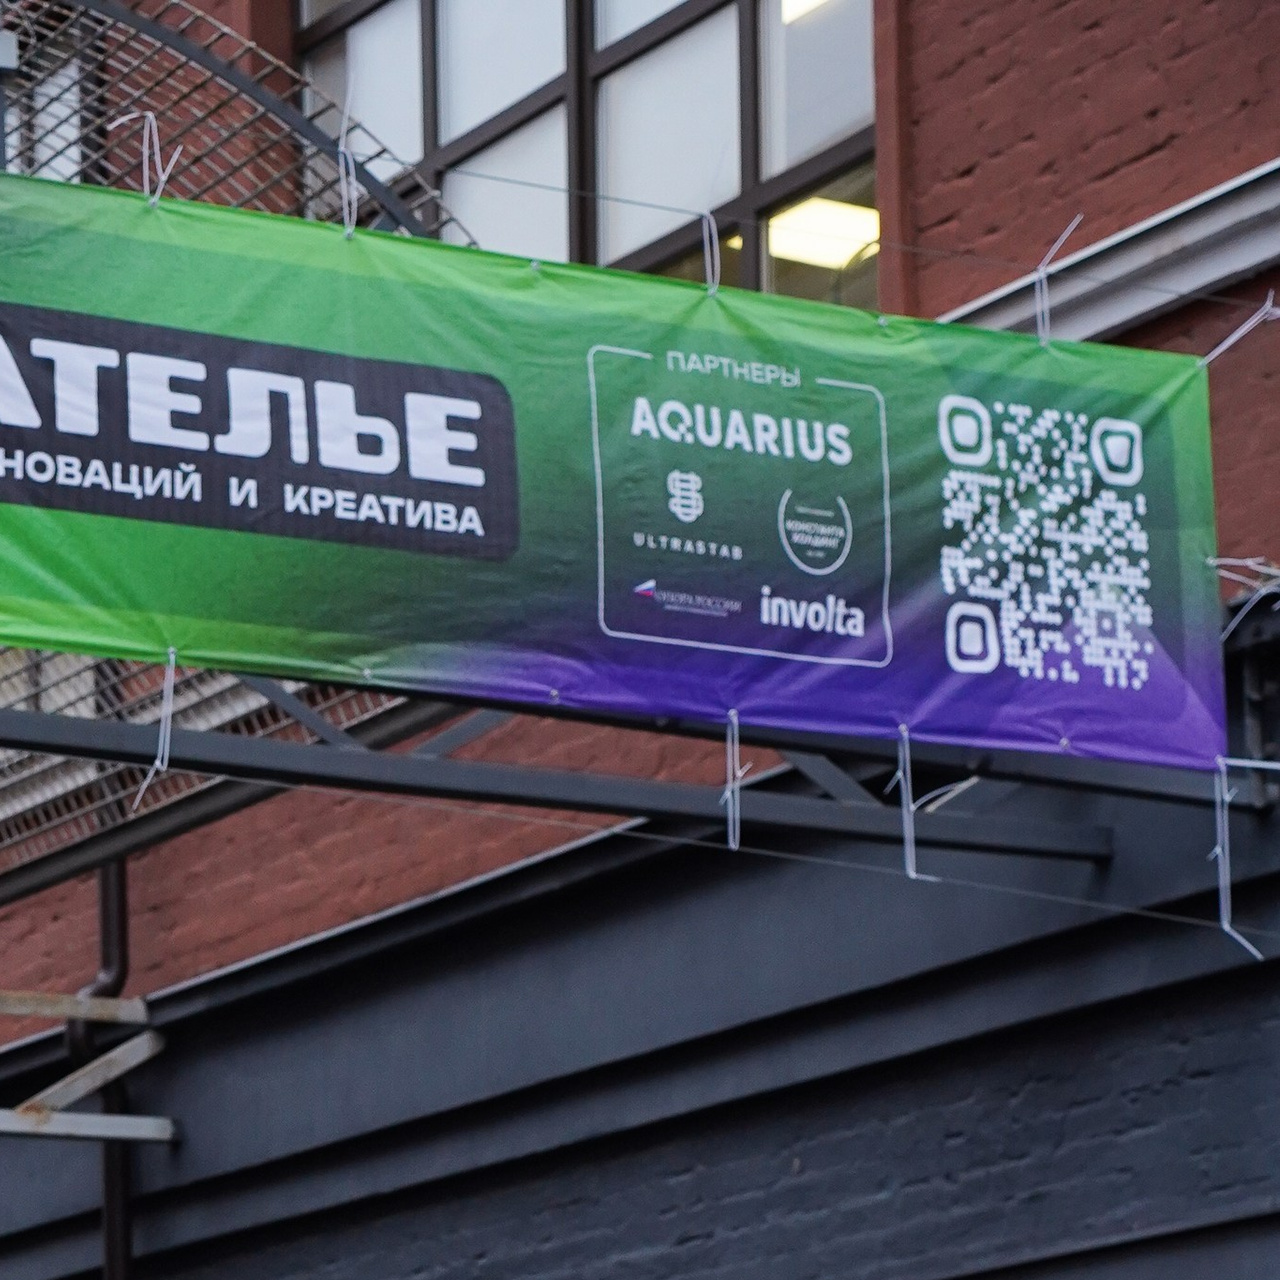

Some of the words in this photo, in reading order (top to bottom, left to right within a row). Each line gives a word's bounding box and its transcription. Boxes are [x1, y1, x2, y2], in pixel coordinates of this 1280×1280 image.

[666, 351, 801, 388] ПАРТНЕРЫ
[631, 397, 853, 466] AQUARIUS
[229, 477, 258, 509] И
[284, 483, 484, 537] КРЕАТИВА
[760, 585, 865, 638] involta
